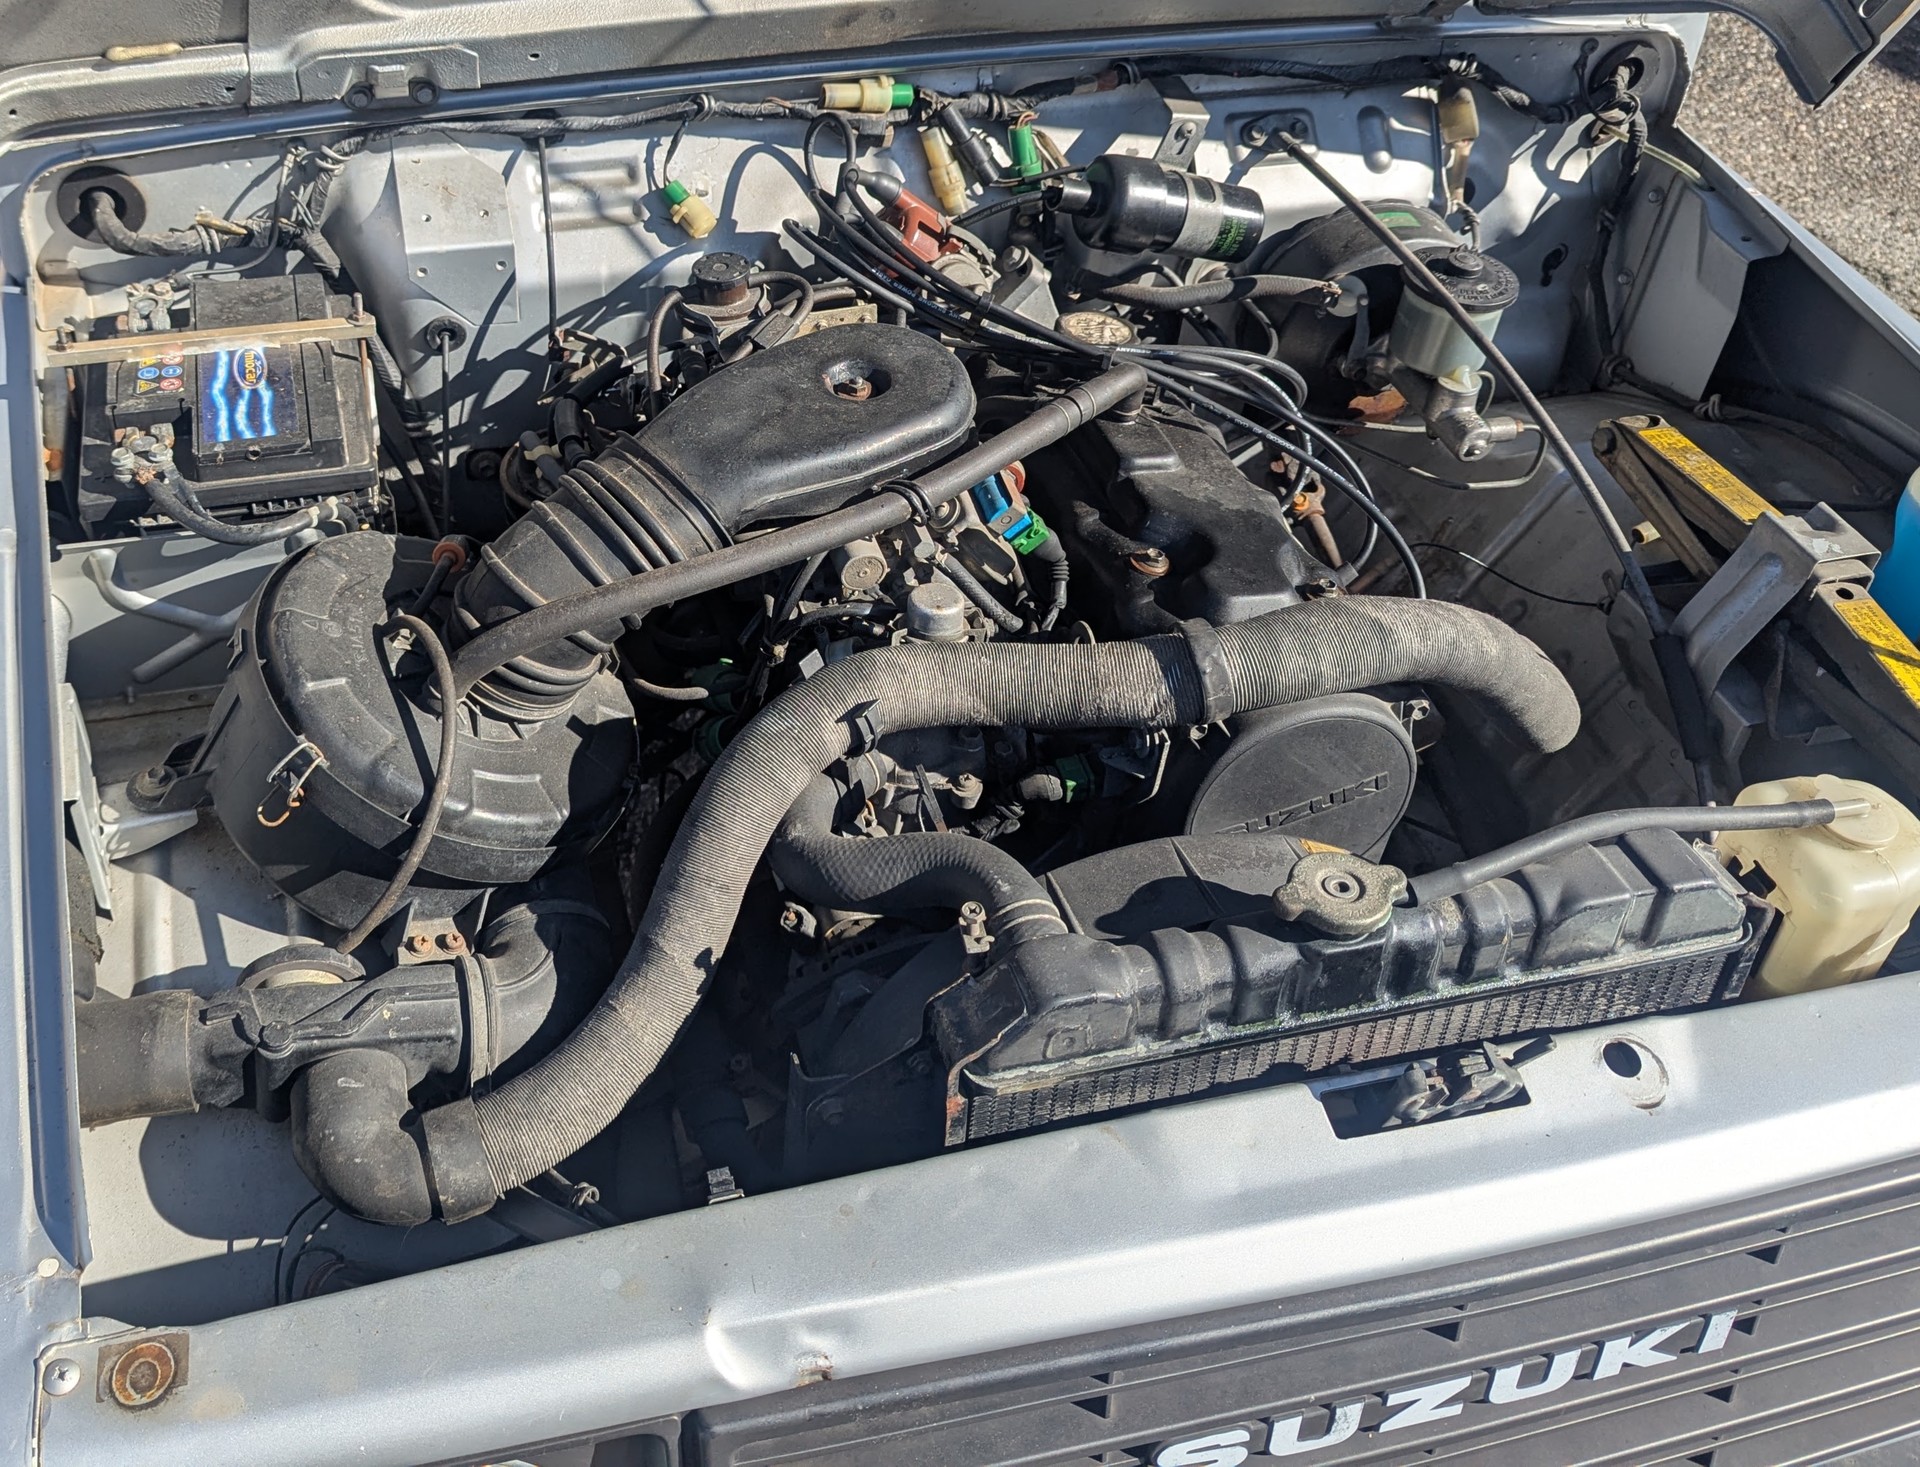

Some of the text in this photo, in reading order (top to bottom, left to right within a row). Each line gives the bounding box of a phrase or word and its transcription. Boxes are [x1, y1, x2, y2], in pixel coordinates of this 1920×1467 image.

[893, 282, 917, 298] POWER
[244, 351, 256, 384] miocar
[1156, 1308, 1738, 1467] SUZUKI
